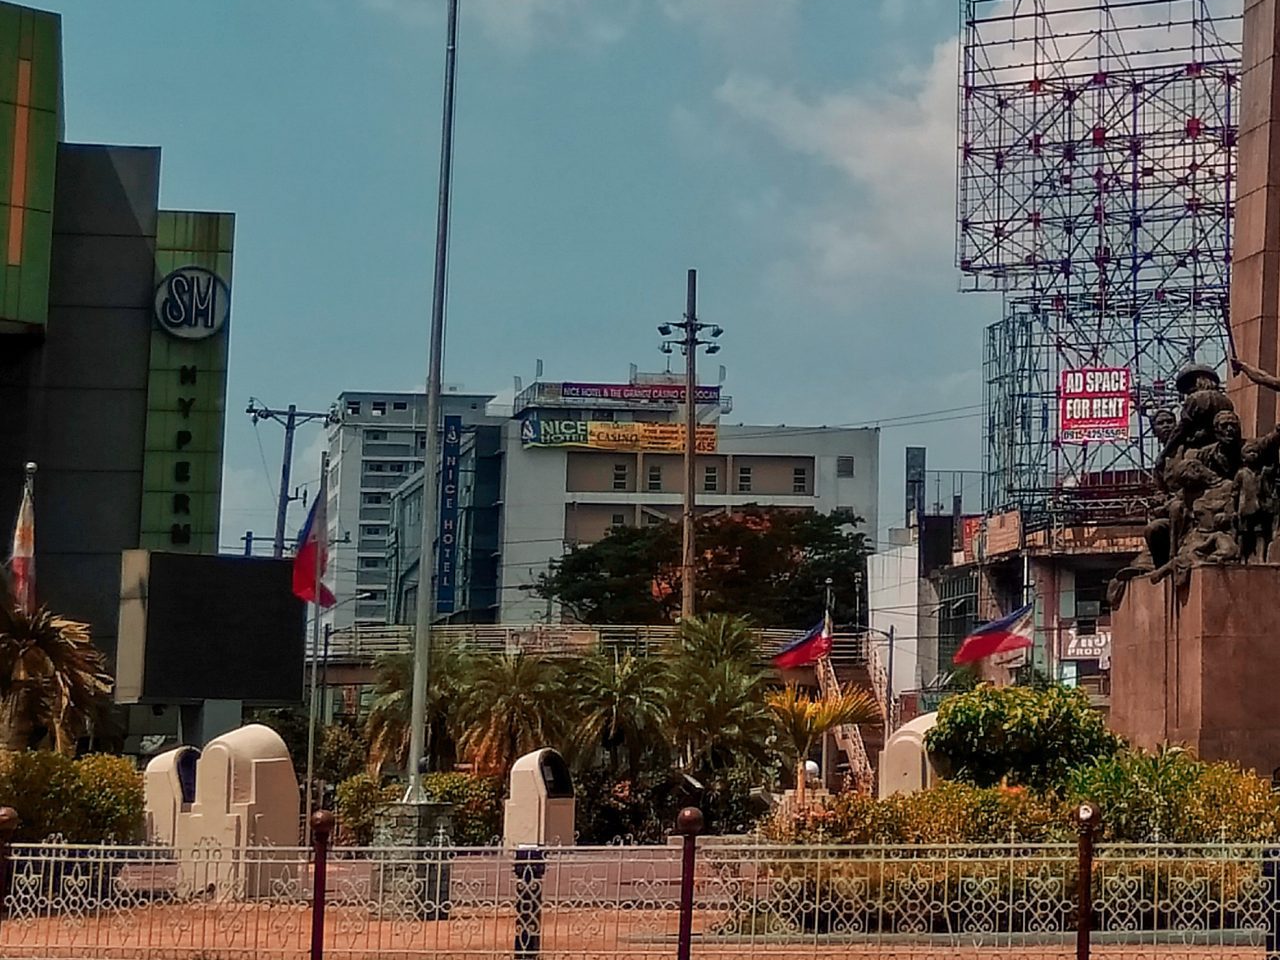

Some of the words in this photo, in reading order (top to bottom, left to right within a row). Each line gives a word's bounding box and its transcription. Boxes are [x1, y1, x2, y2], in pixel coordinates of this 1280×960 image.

[162, 273, 218, 328] SM
[1066, 372, 1083, 393] AD
[1086, 371, 1126, 392] SPACE
[1066, 398, 1090, 419] FOR
[1092, 398, 1125, 418] RENT
[540, 421, 588, 435] NICE
[541, 434, 588, 444] HOTEL
[445, 456, 456, 509] NICE
[442, 519, 454, 587] HOTEL
